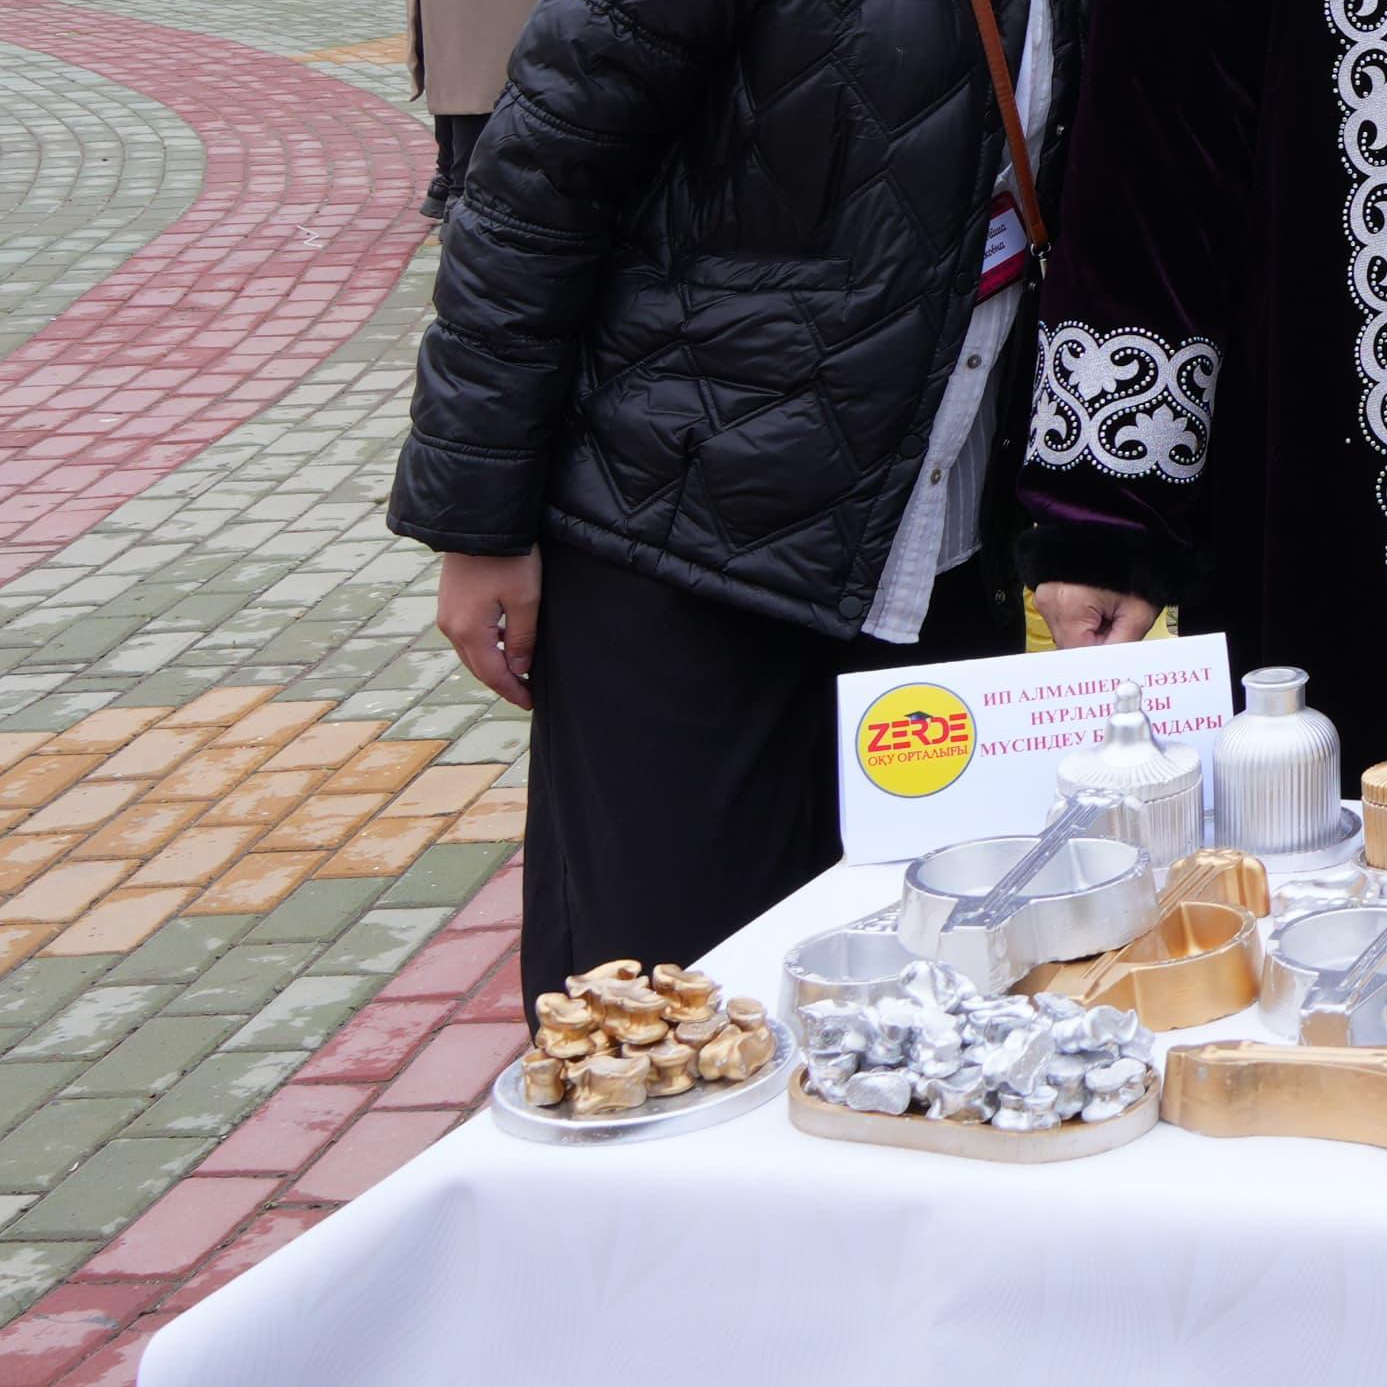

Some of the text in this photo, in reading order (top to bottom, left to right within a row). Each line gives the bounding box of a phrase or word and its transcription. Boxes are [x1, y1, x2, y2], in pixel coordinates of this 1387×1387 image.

[983, 689, 1012, 706] ИП
[1141, 667, 1212, 688] ЛӘЗЗАТ
[868, 712, 969, 753] ZERDE
[980, 730, 1087, 758] МҮСІНДЕУ
[868, 745, 968, 768] ОҚУ ОРТАЛЫҒЫ
